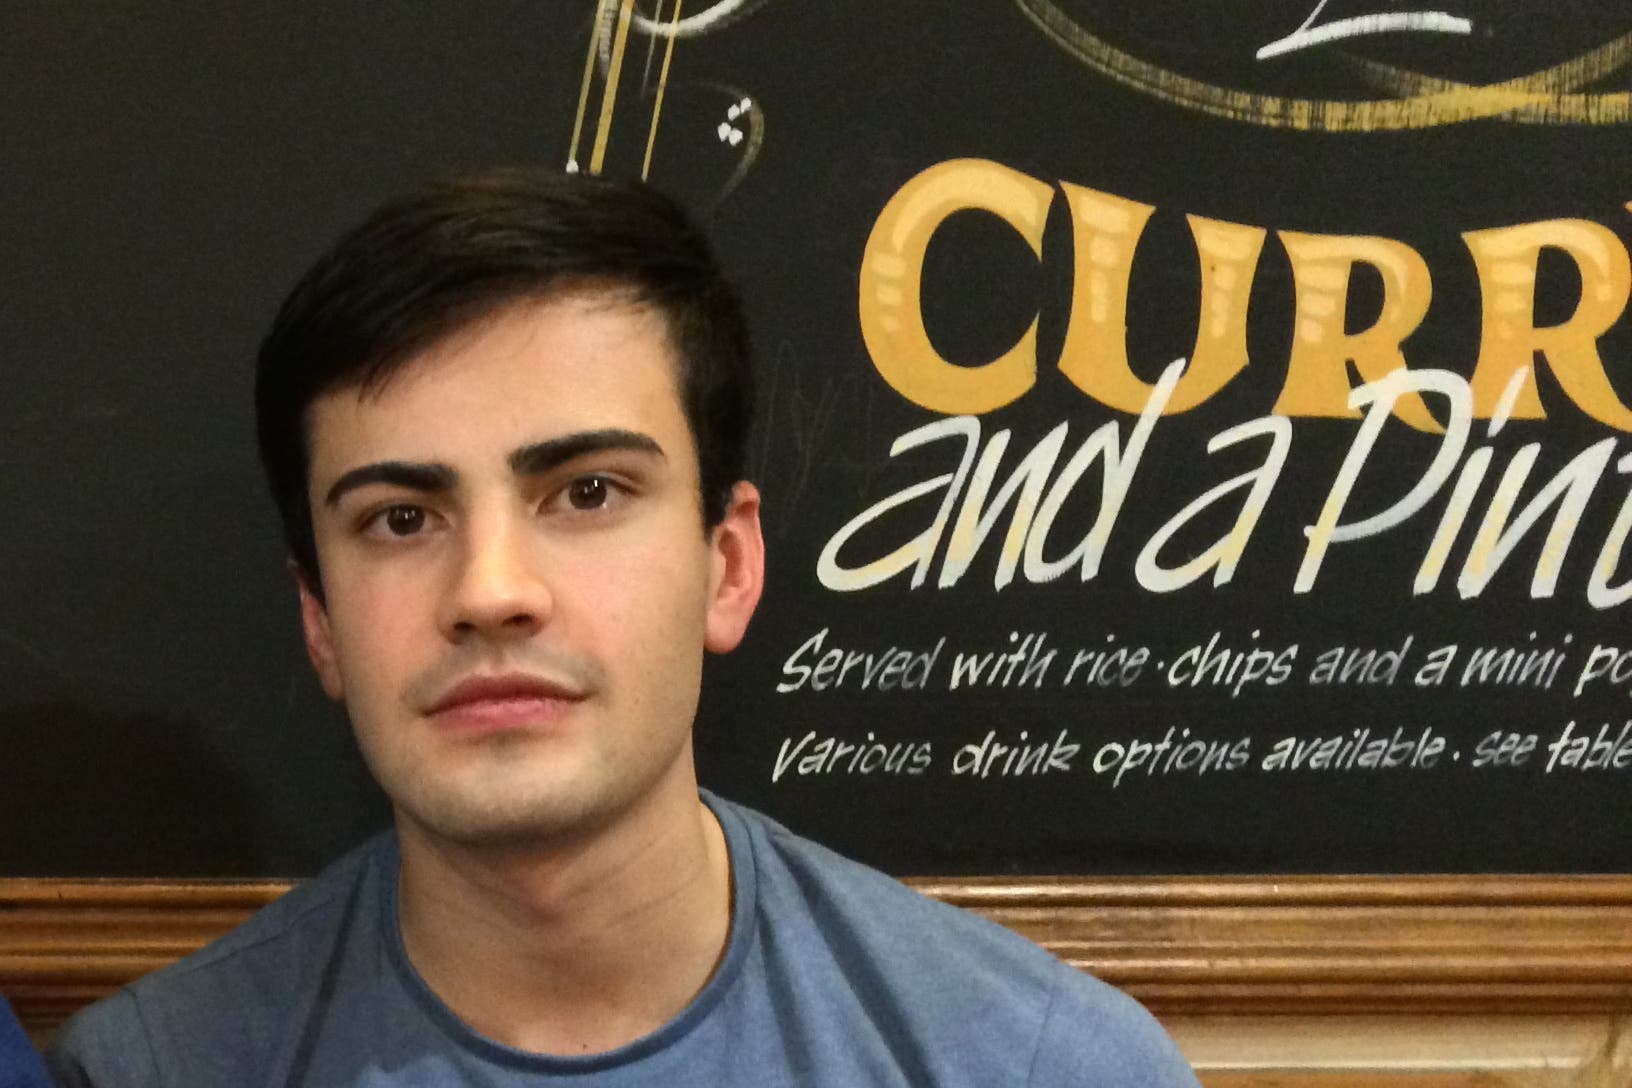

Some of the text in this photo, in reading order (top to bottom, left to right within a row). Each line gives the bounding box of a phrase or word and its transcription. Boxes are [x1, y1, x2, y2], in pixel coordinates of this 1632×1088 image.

[858, 157, 1632, 433] CURR
[817, 357, 1187, 592] and
[1135, 415, 1293, 593] a
[776, 627, 946, 692] Served
[949, 631, 1058, 691] with
[1168, 630, 1299, 698] chips
[1308, 633, 1414, 686] and
[1414, 643, 1458, 687] a
[1460, 630, 1573, 690] mini
[1573, 644, 1632, 697] po
[771, 730, 932, 783] Various
[951, 728, 1081, 779] drink
[1091, 725, 1251, 789] options
[1472, 730, 1538, 769] see
[1546, 720, 1632, 774] table
